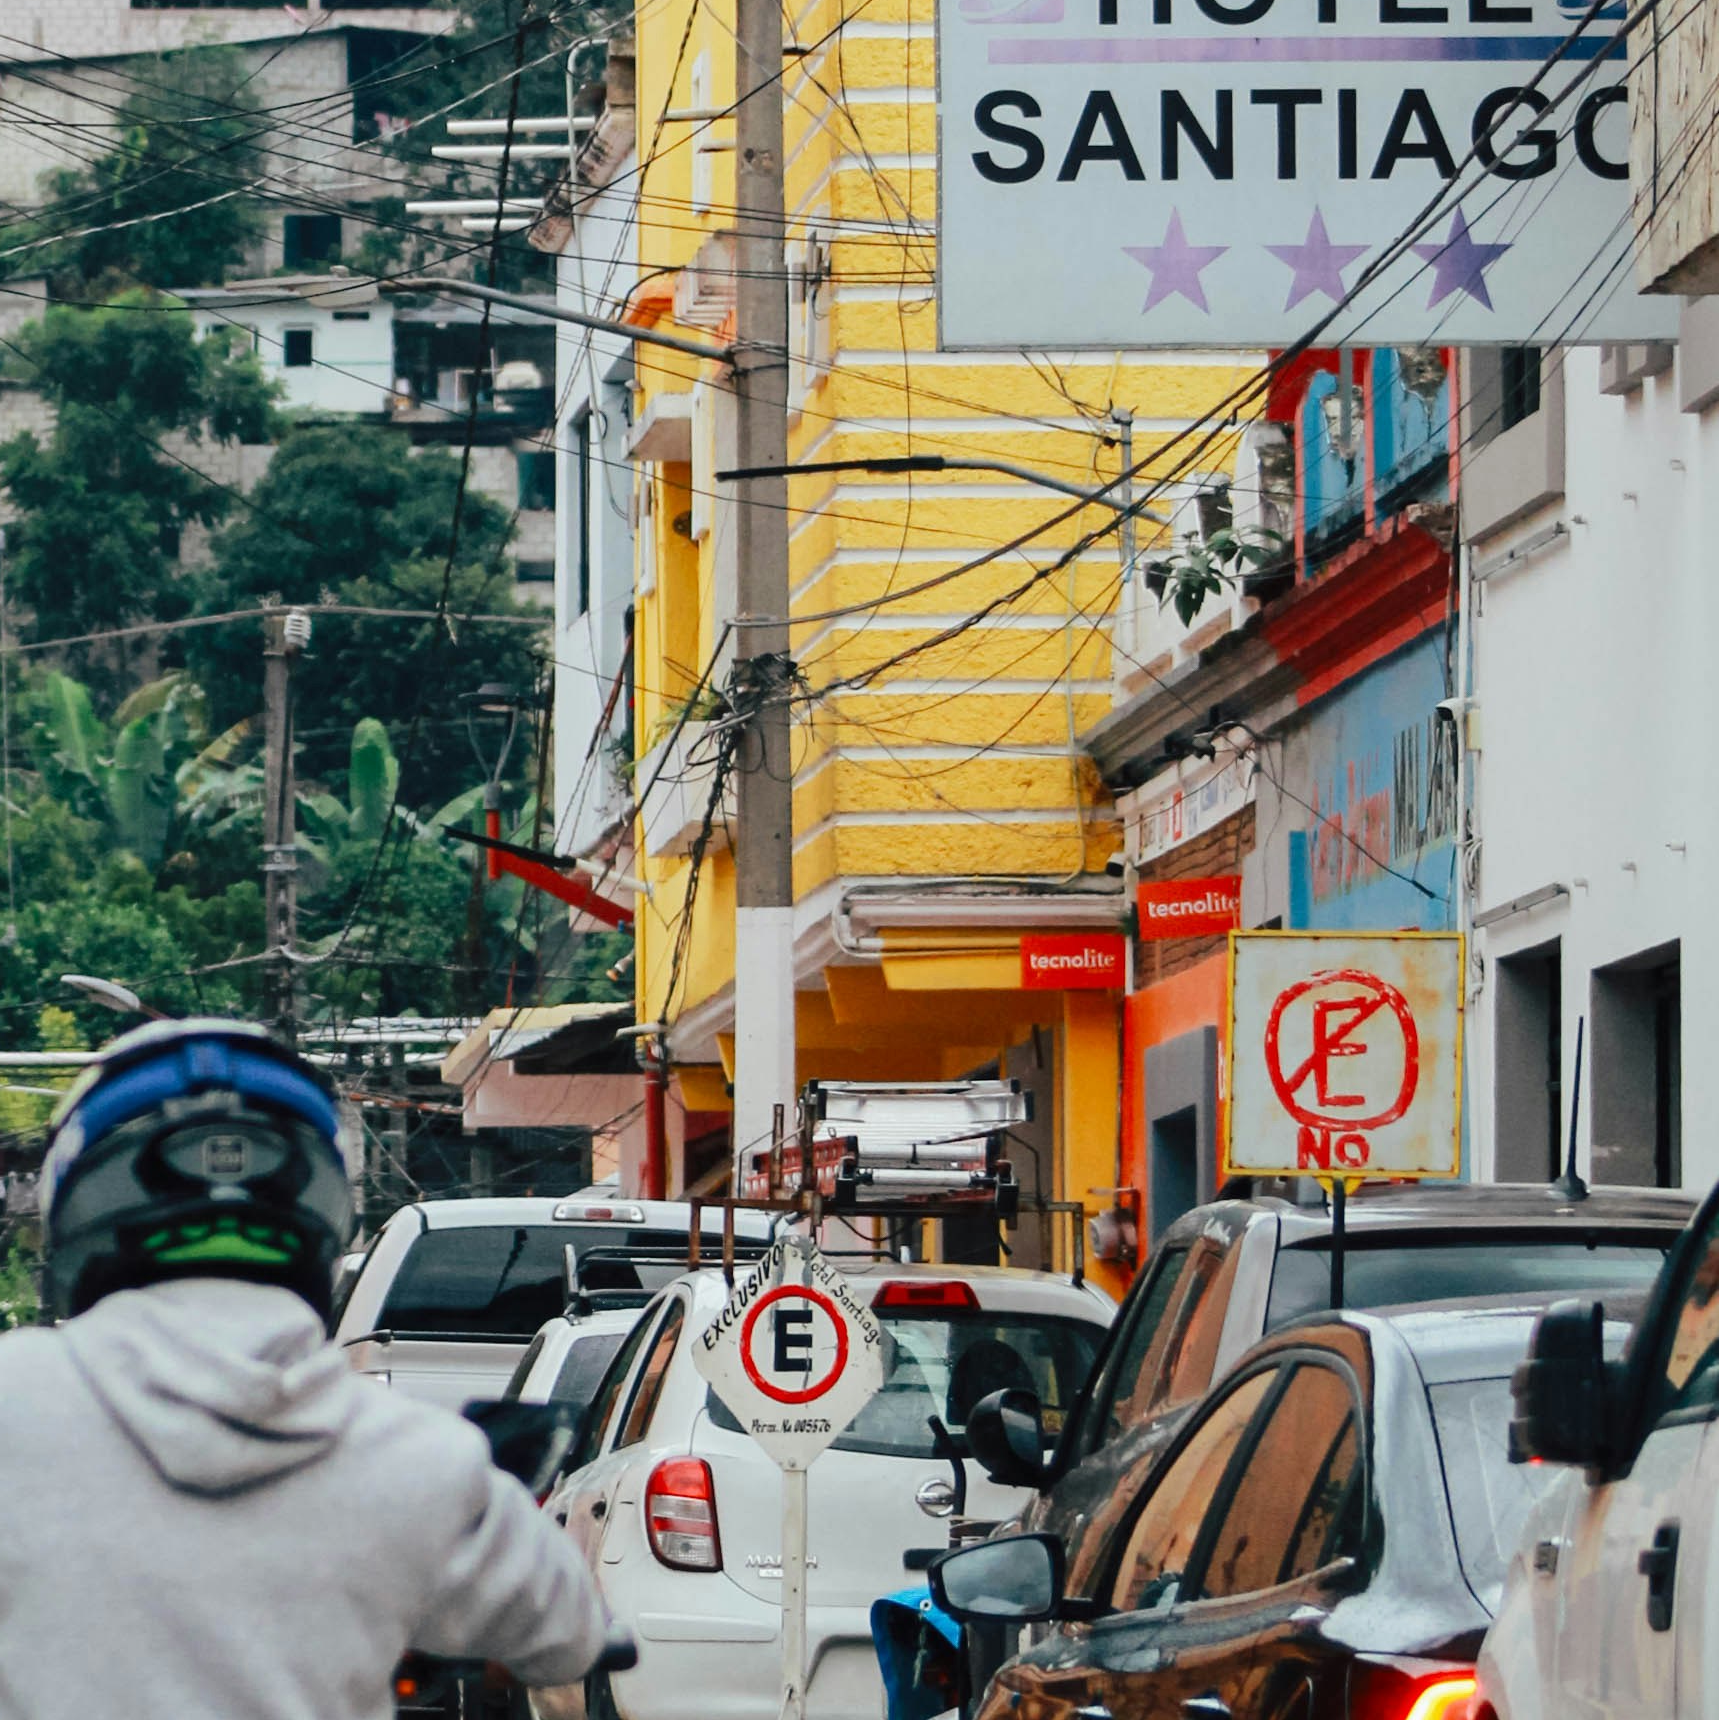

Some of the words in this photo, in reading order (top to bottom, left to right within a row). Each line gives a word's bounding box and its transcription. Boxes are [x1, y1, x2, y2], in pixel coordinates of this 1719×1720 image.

[1148, 892, 1240, 918] tecnolite
[1030, 949, 1115, 969] tecnolite
[1313, 997, 1367, 1107] E
[1297, 1126, 1369, 1169] NO
[702, 1244, 780, 1351] EXCLUSIVO
[774, 1310, 813, 1372] E
